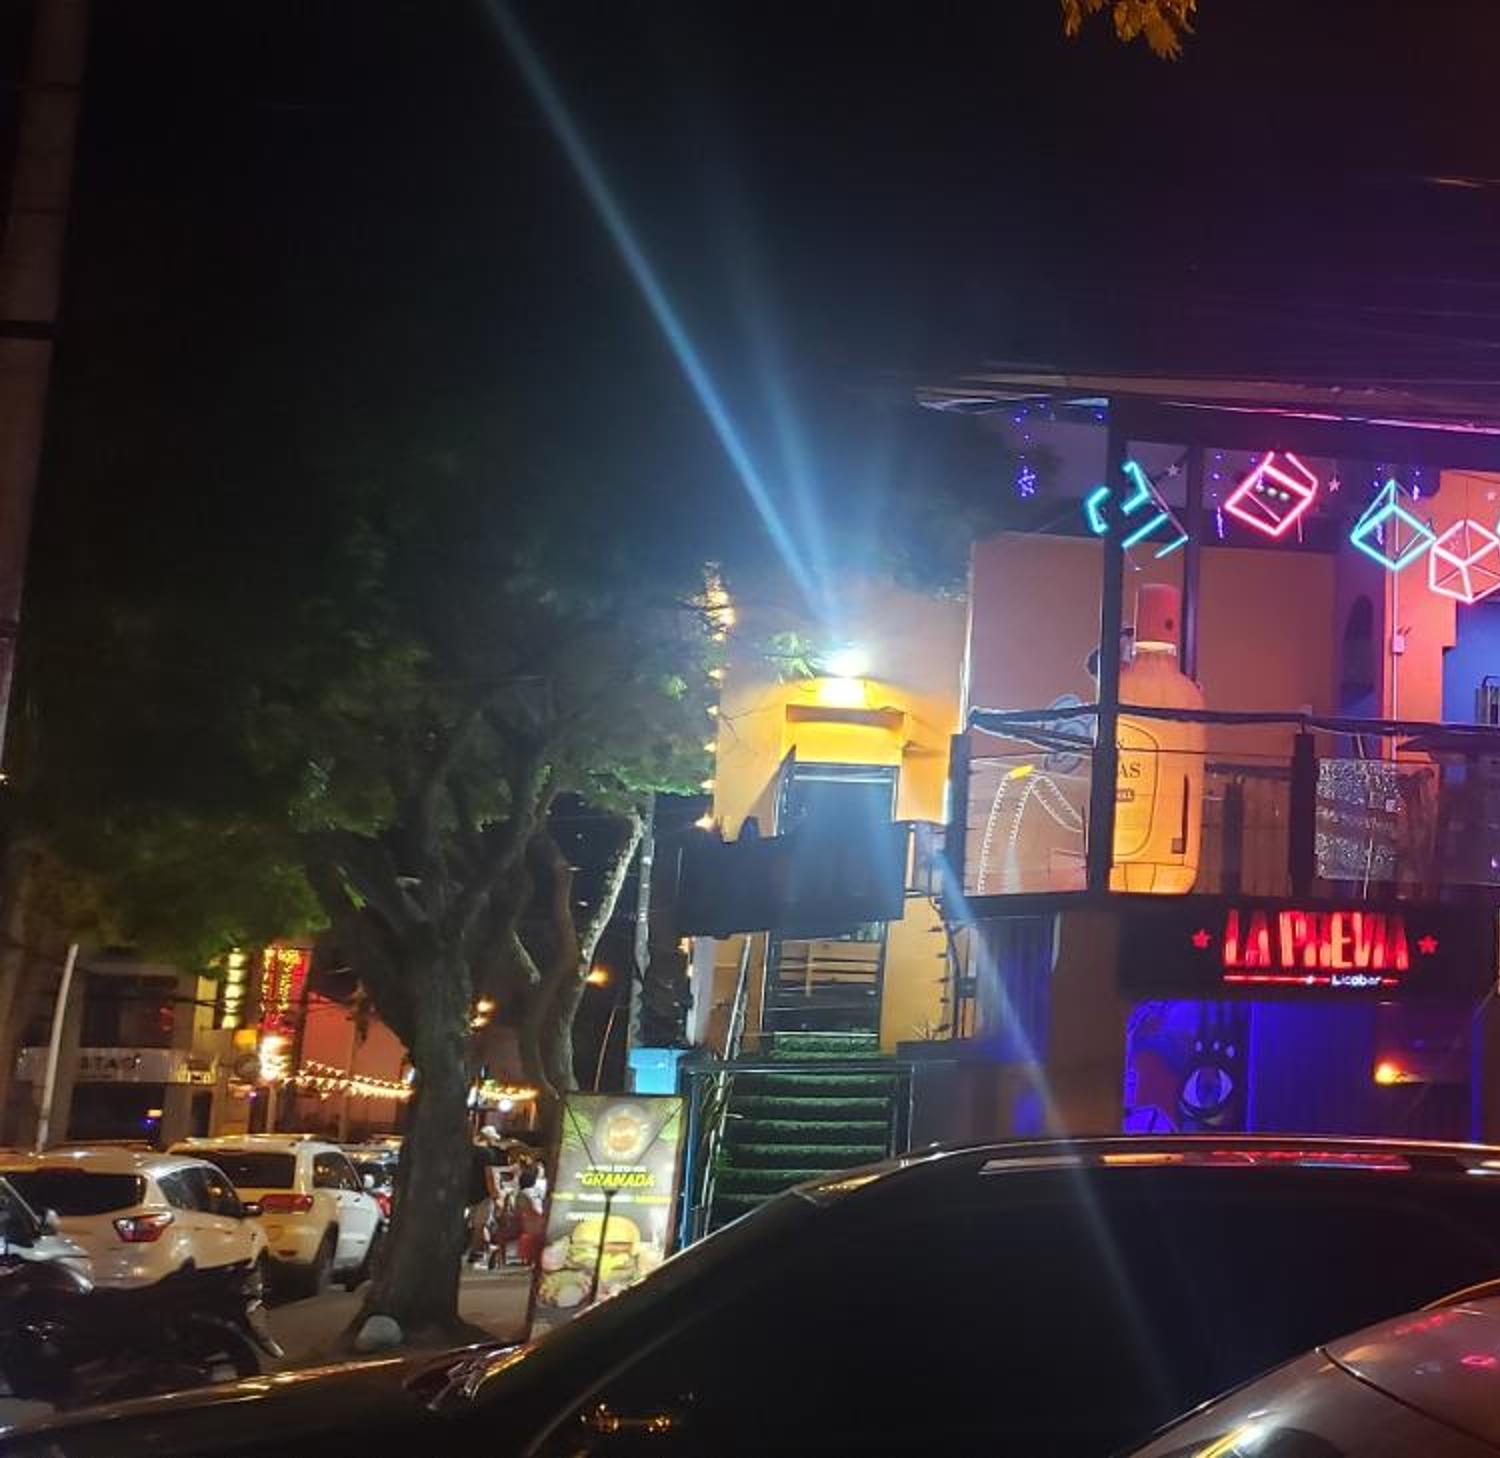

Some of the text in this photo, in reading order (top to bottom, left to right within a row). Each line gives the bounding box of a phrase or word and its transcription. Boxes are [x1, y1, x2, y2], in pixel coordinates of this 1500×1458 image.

[1224, 910, 1409, 969] LA PREVIA
[581, 1172, 655, 1187] GRANADA
